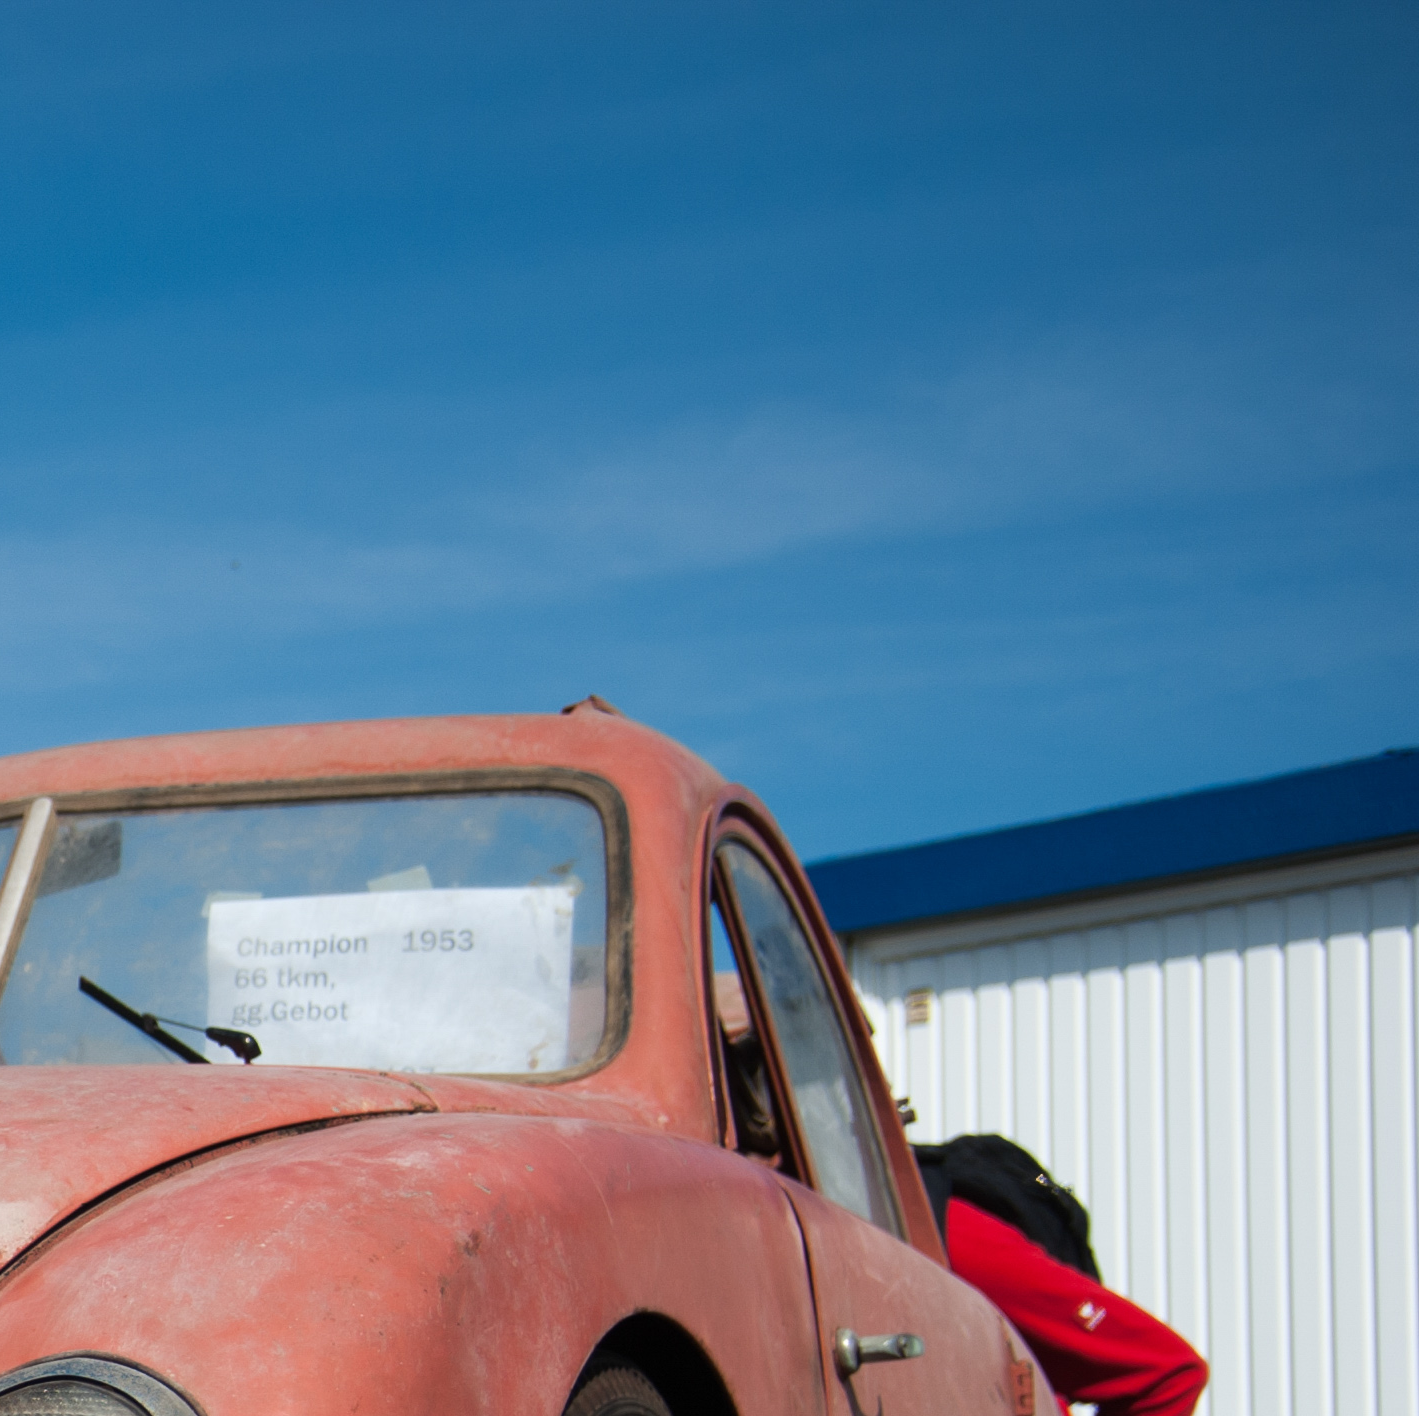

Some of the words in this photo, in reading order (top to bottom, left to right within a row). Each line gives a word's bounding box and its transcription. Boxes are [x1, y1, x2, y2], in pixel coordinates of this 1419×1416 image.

[236, 933, 369, 959] Champion
[401, 929, 475, 953] 1953
[235, 967, 269, 990] 66
[276, 967, 337, 992] tkm,
[230, 1000, 349, 1027] gg.Gebot
